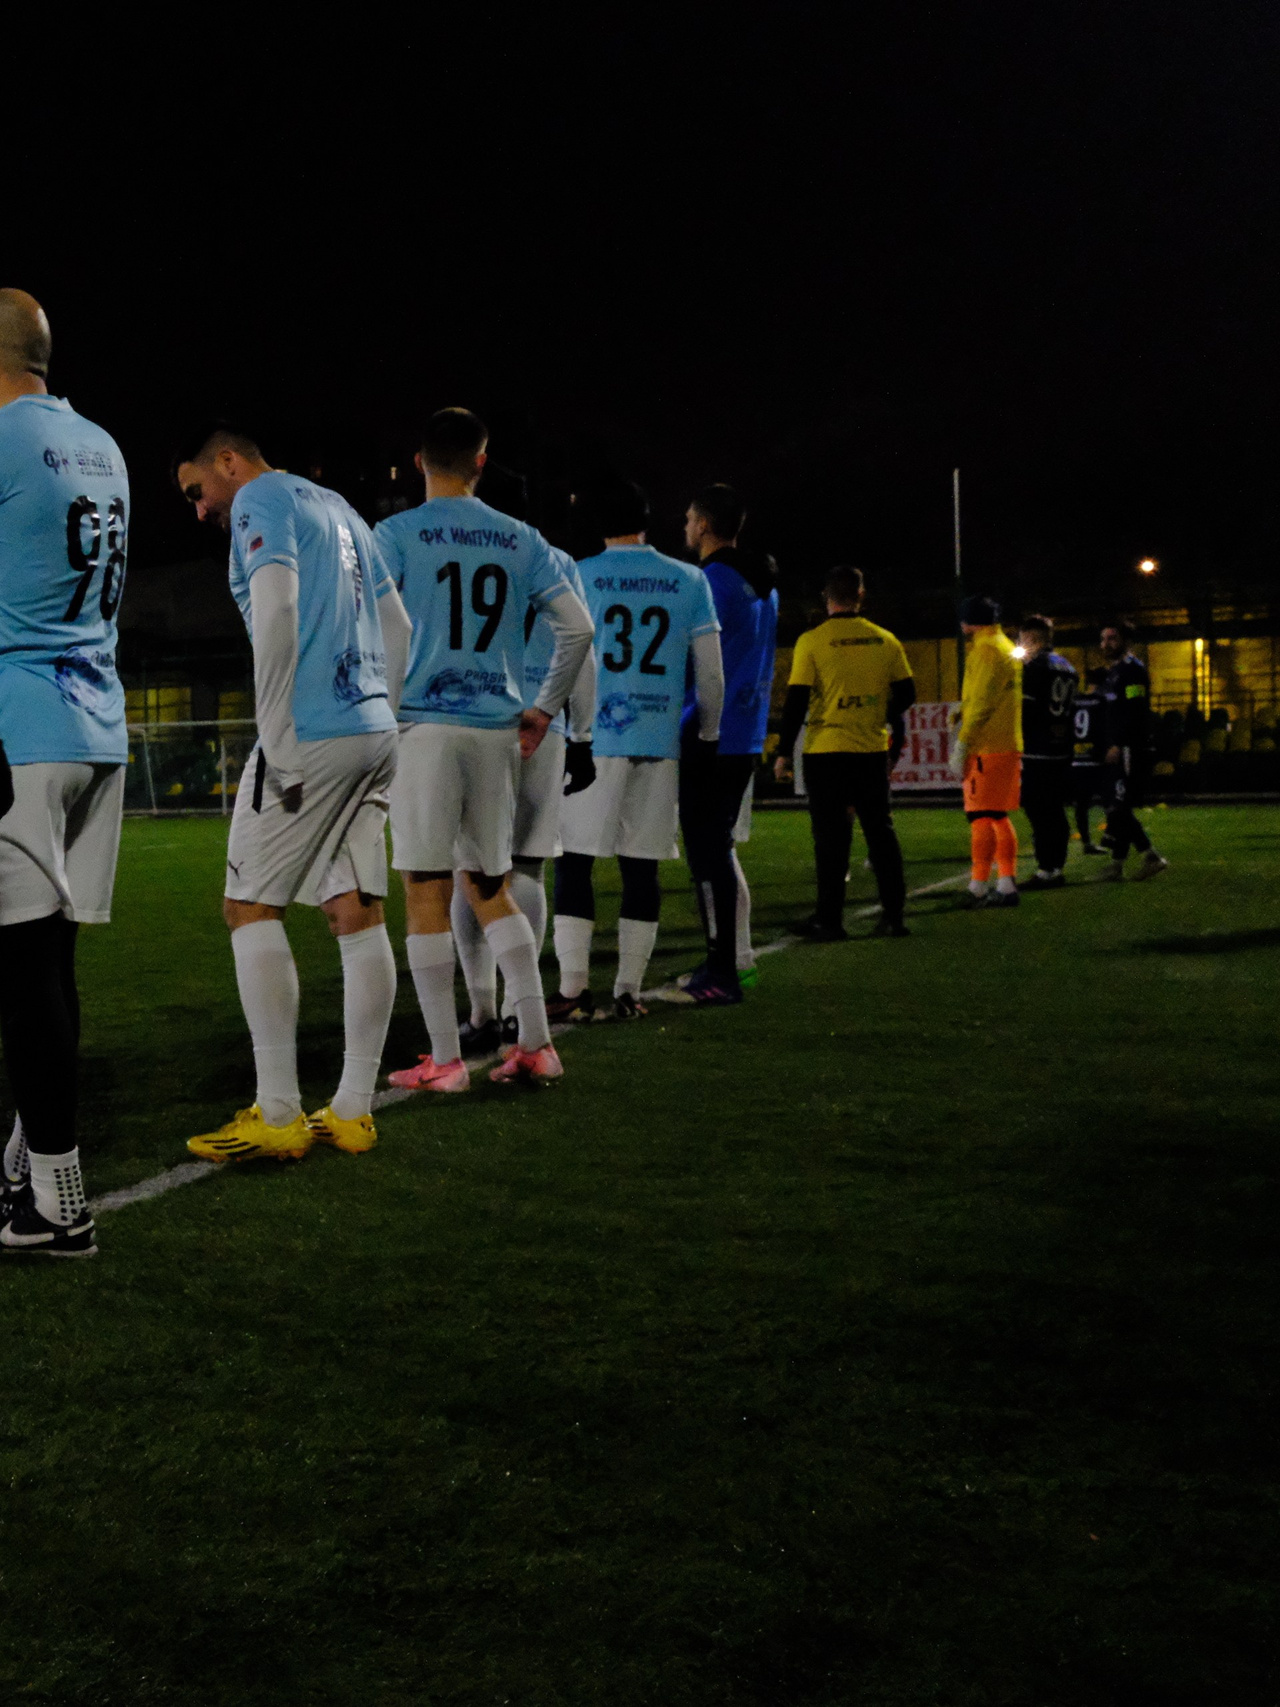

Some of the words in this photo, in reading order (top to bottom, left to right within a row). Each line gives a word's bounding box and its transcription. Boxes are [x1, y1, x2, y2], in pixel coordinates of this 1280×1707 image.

[419, 527, 447, 546] ФК
[450, 526, 518, 550] ИМПУЛЬС
[594, 577, 616, 592] ФК
[437, 561, 508, 652] 19
[603, 604, 670, 675] 32
[1074, 708, 1090, 739] 9
